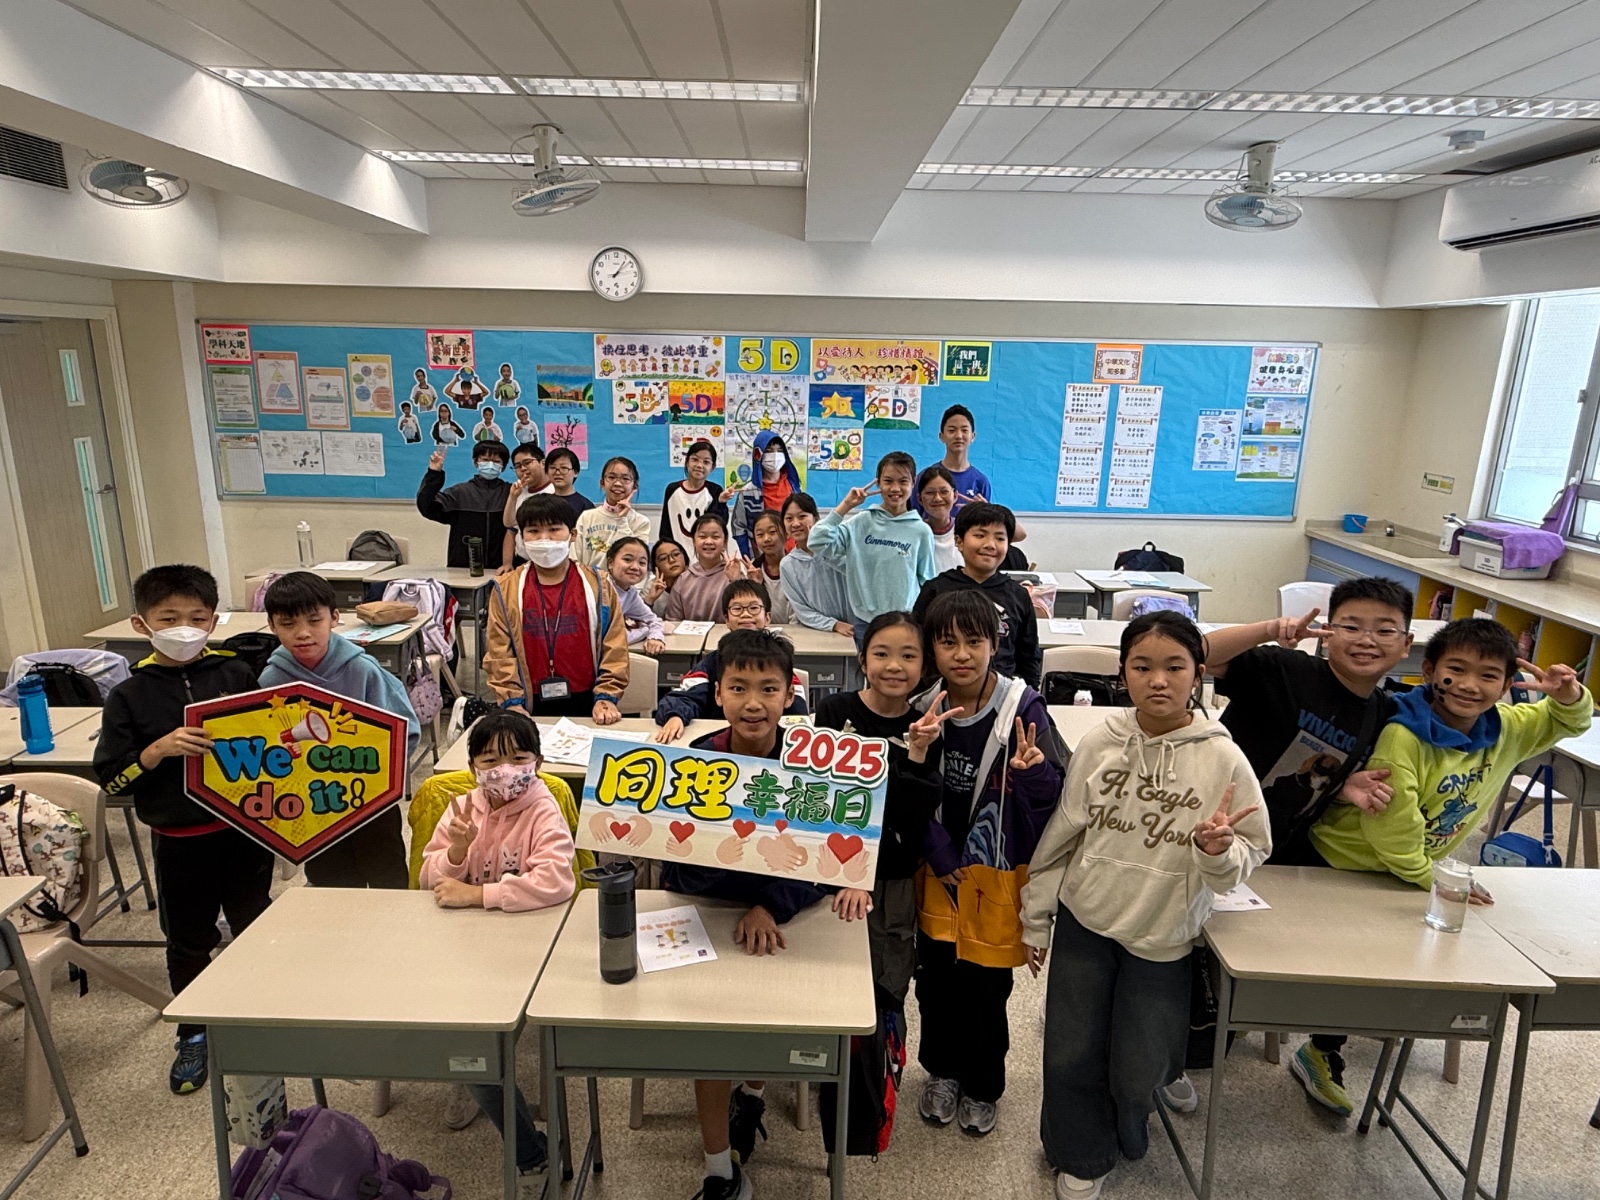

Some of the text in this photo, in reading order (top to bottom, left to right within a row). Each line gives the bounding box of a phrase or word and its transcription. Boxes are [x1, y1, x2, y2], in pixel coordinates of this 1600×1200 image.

[959, 350, 978, 361] 我們
[625, 393, 658, 413] 5D
[681, 393, 712, 414] 5D
[820, 440, 850, 460] 5D
[865, 535, 911, 551] Cinnamoroll
[210, 736, 381, 783] We can
[785, 727, 883, 778] 2025
[238, 777, 366, 821] do it!
[1099, 768, 1203, 814] A. Eagle
[1087, 804, 1136, 834] New
